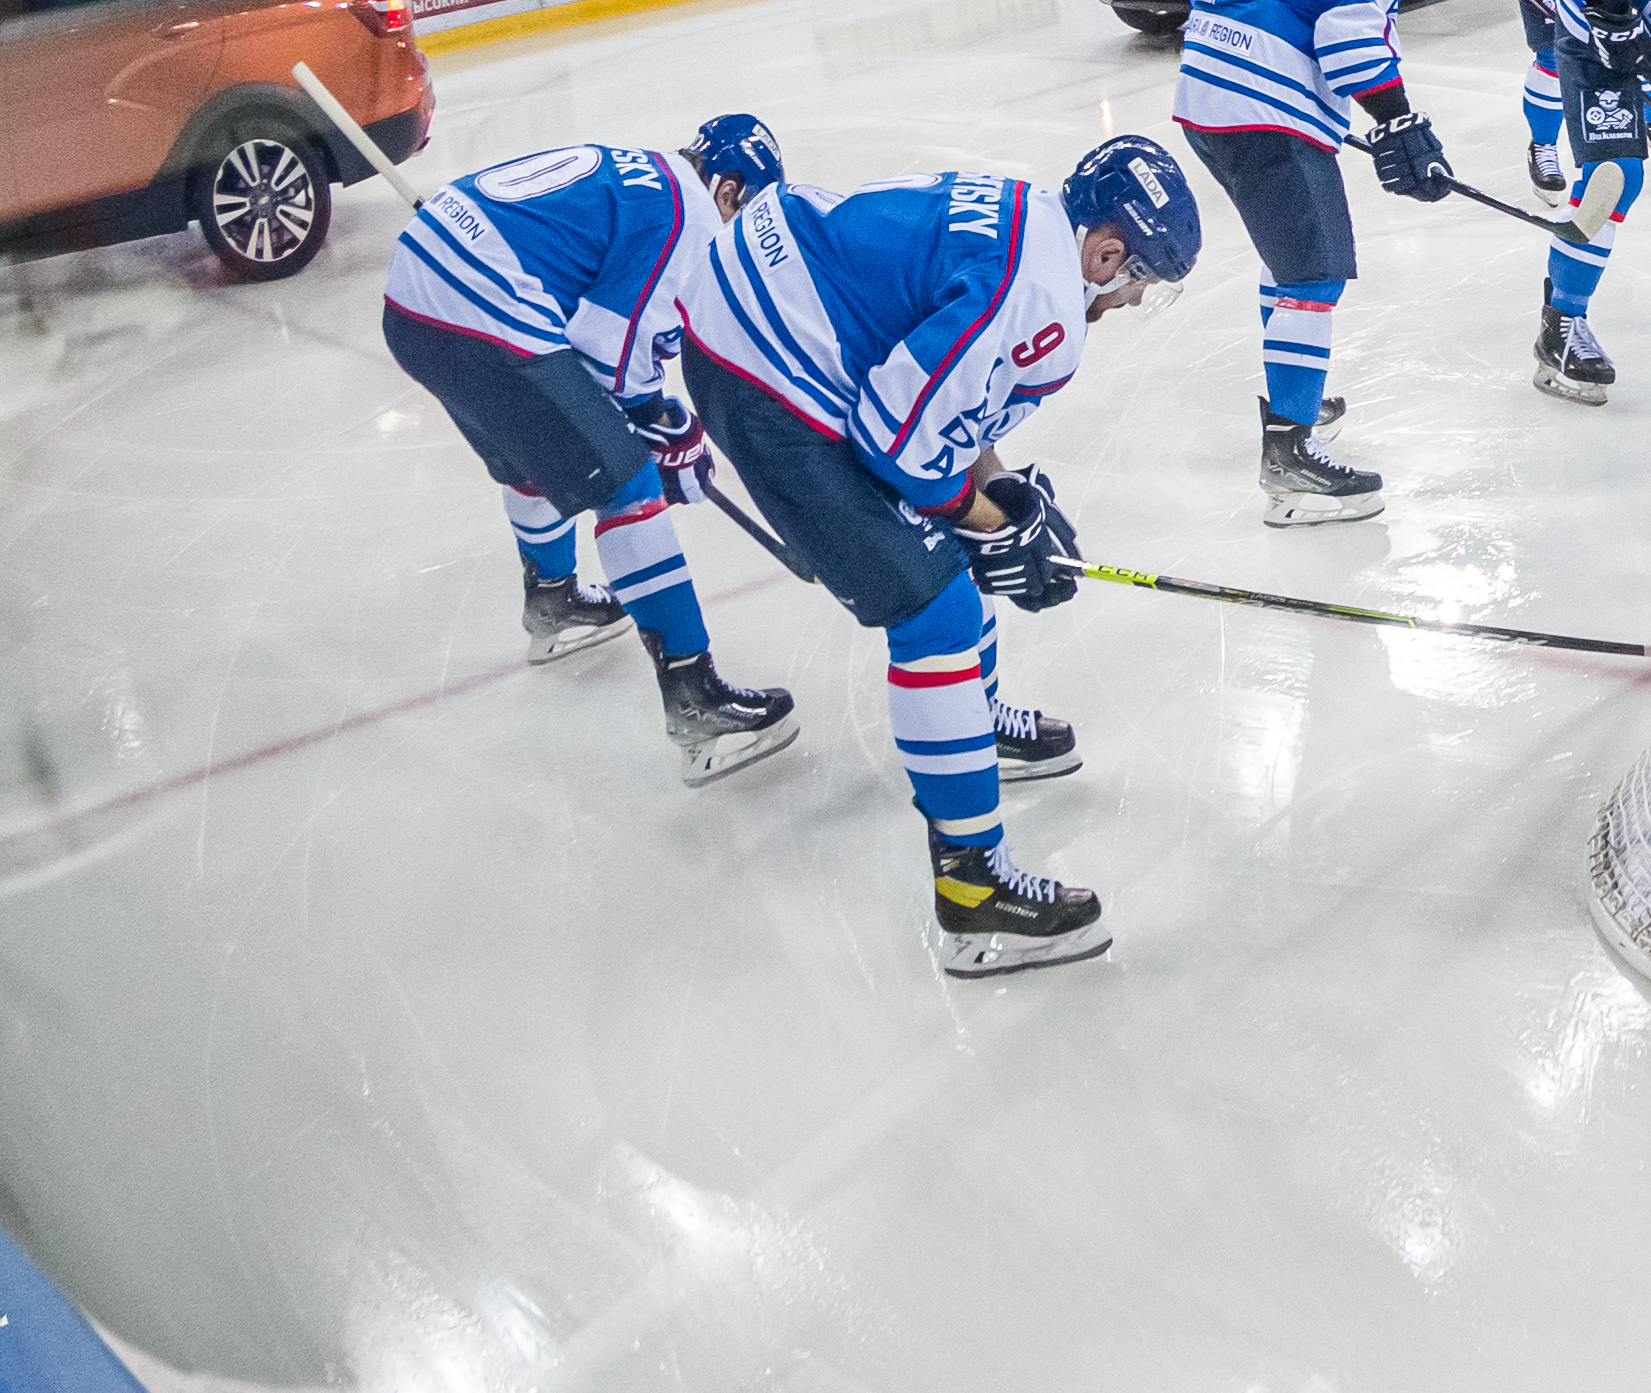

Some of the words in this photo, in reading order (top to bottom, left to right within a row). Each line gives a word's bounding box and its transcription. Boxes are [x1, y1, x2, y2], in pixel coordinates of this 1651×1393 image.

[1208, 22, 1254, 51] REGION
[1593, 22, 1646, 43] CCM
[1132, 159, 1166, 207] LADA
[441, 193, 485, 242] REGION
[754, 203, 790, 268] REGION
[1122, 202, 1154, 236] BAUER
[1014, 321, 1067, 368] 9
[1097, 564, 1149, 581] CCM
